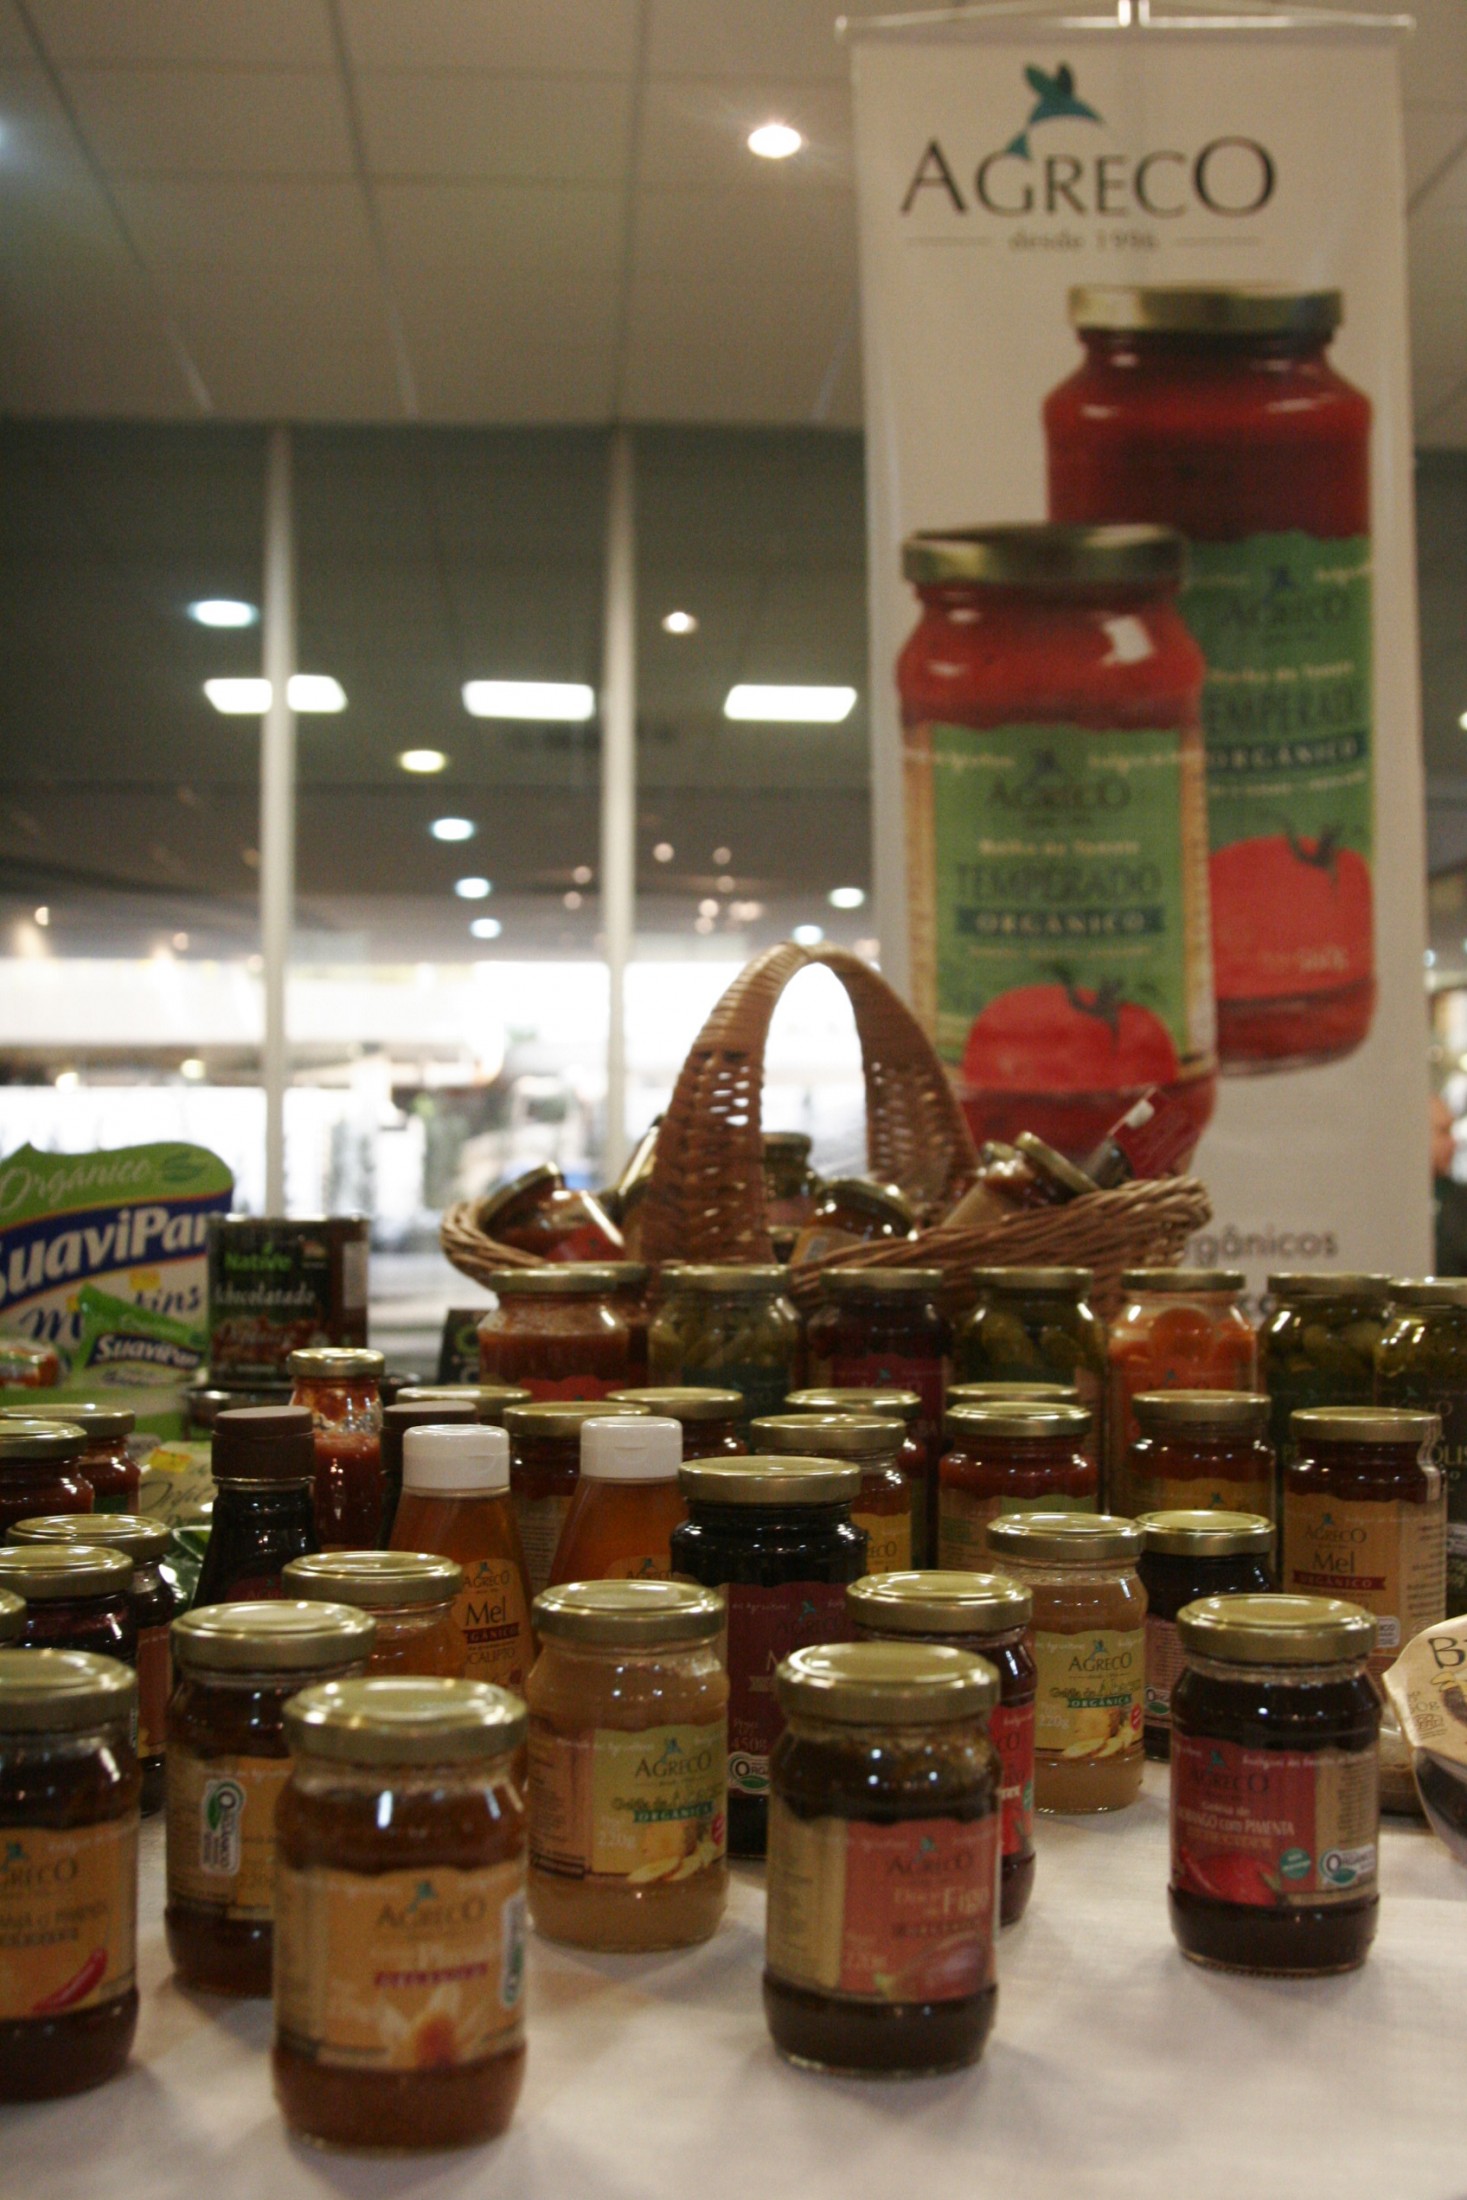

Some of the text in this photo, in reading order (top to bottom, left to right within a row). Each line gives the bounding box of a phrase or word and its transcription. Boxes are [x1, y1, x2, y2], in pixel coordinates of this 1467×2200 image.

[899, 134, 1278, 218] AGRECO
[1312, 1551, 1355, 1574] Mel
[463, 1569, 511, 1588] AGRECO
[466, 1596, 507, 1626] Mel
[1068, 1651, 1132, 1672] AGRECO
[634, 1751, 712, 1779] AGRECO
